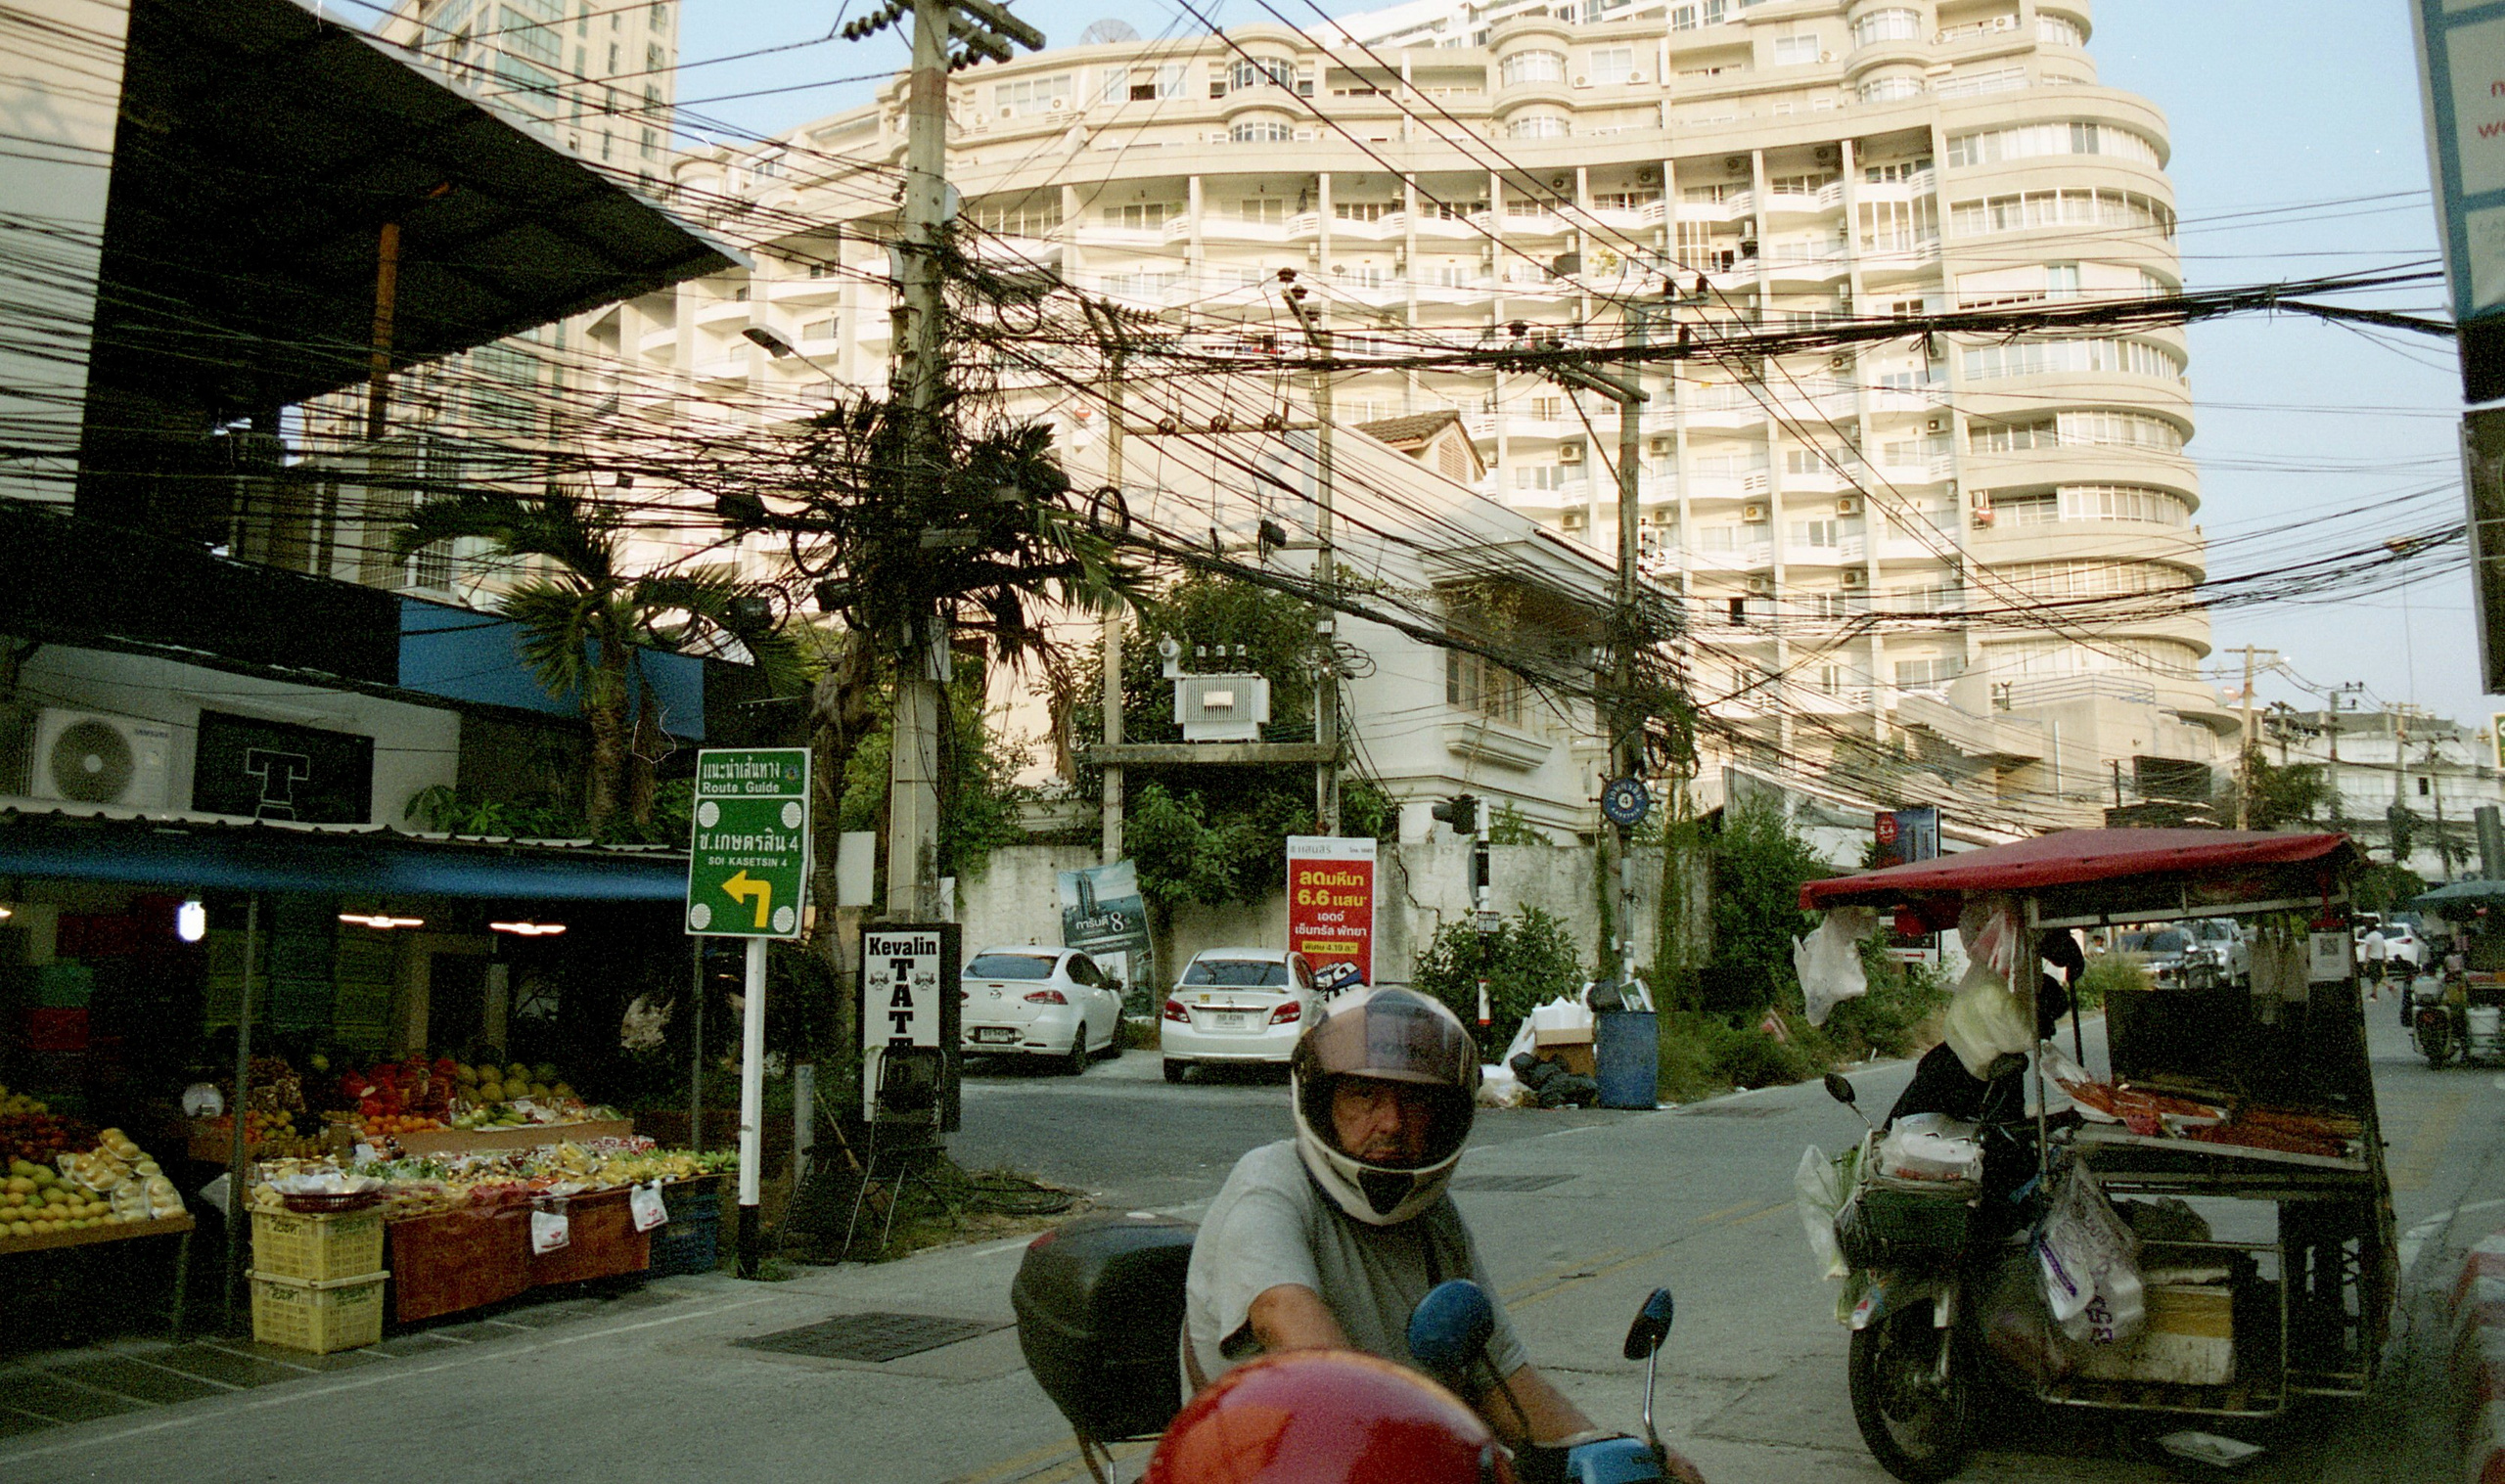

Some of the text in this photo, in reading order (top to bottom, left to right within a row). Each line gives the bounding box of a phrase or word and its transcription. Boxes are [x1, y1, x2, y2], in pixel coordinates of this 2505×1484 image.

[703, 755, 781, 779] แนะนำเส้นทาง
[703, 781, 780, 793] Route Guide
[1620, 796, 1628, 805] 4
[789, 835, 798, 852] 4
[707, 856, 788, 868] SOI KASETSIN 4
[1298, 888, 1330, 907] 6.6
[1110, 911, 1124, 932] 8
[1295, 922, 1368, 937] เซ็นทรัล พัทยา
[868, 936, 937, 956] Kevalin
